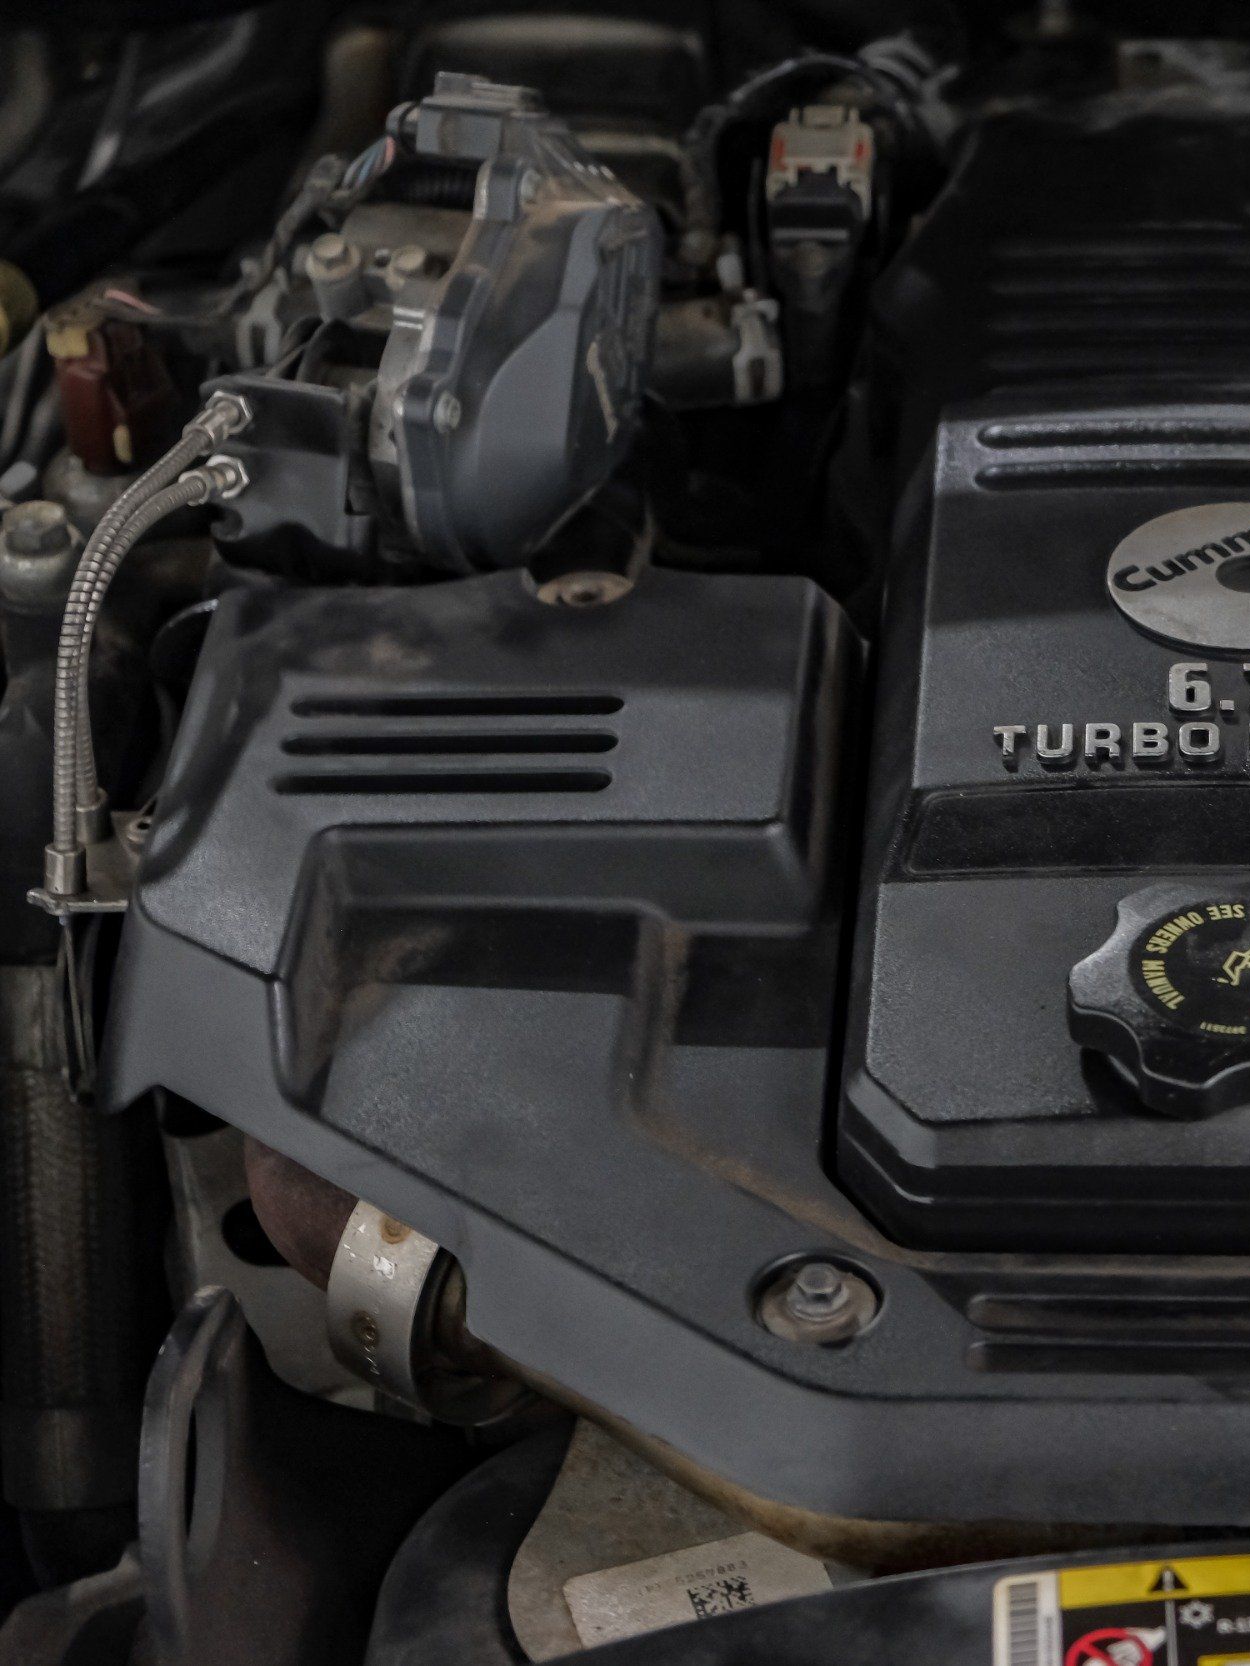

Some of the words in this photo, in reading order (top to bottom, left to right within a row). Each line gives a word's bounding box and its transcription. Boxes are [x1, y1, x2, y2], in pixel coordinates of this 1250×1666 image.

[994, 722, 1222, 765] TURBO
[1146, 911, 1204, 954] OWNERS
[1206, 904, 1245, 921] SEE
[1142, 960, 1186, 1010] MANUAL
